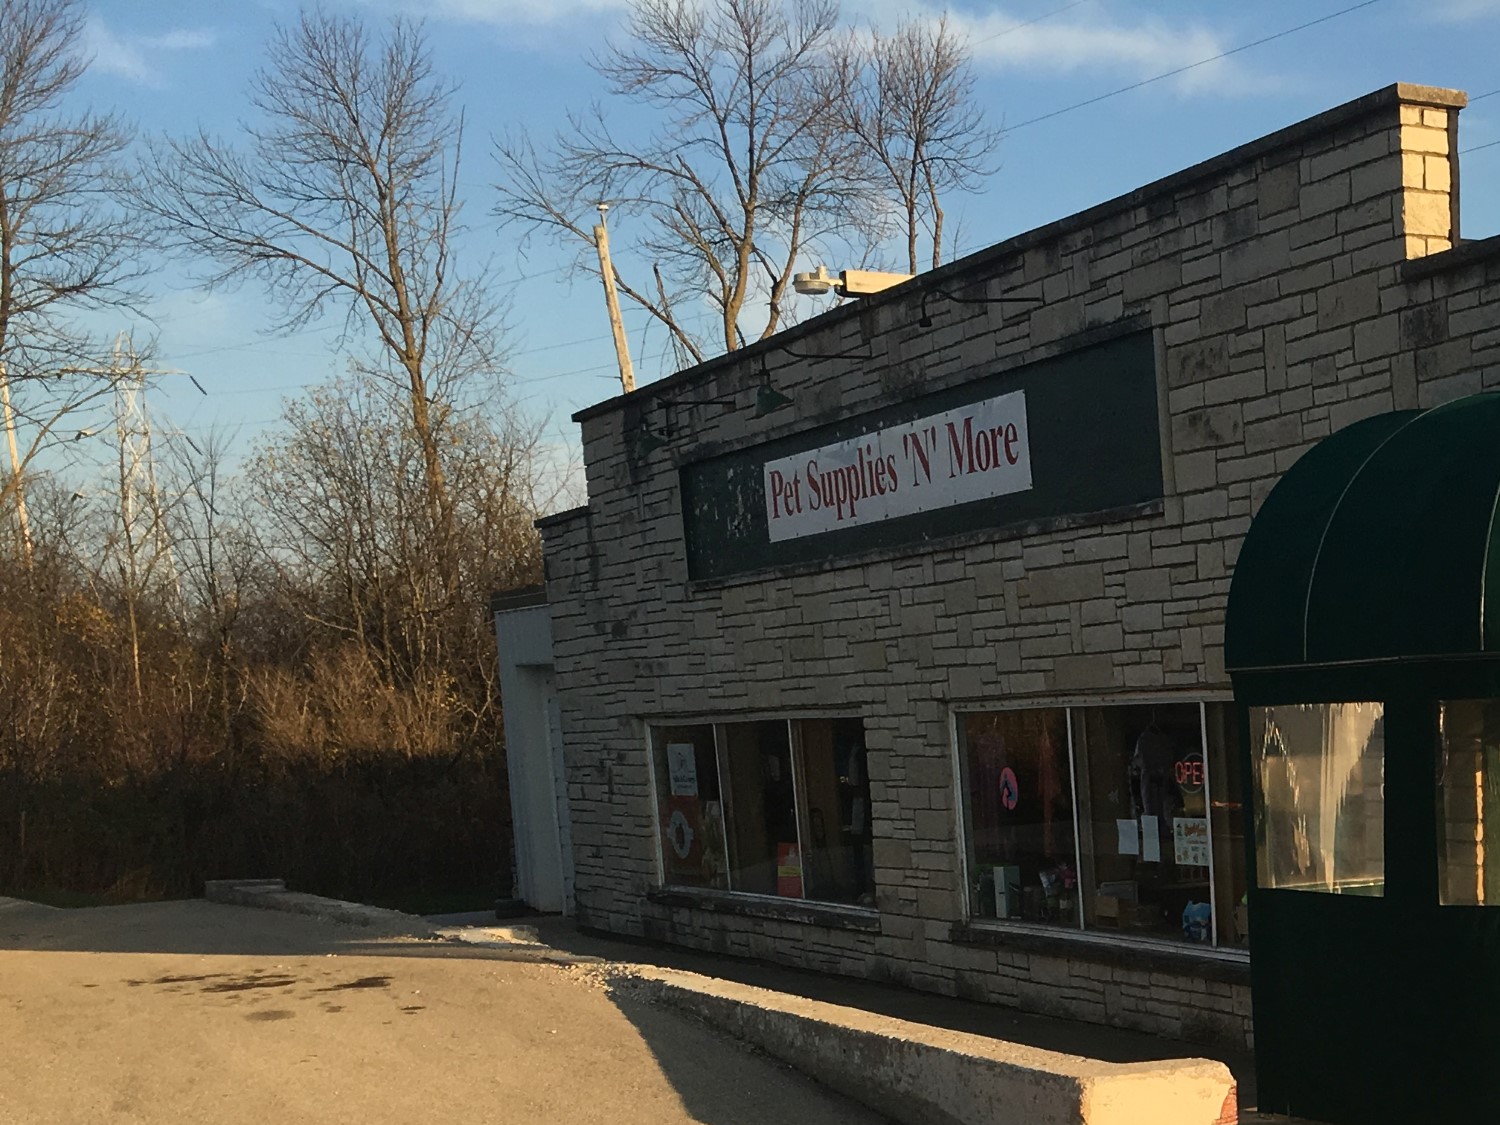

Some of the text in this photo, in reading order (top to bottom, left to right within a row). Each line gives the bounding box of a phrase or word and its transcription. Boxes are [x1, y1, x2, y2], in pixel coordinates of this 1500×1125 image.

[769, 416, 1019, 520] Pet Supplies 'N' More
[1174, 761, 1205, 785] OPE
